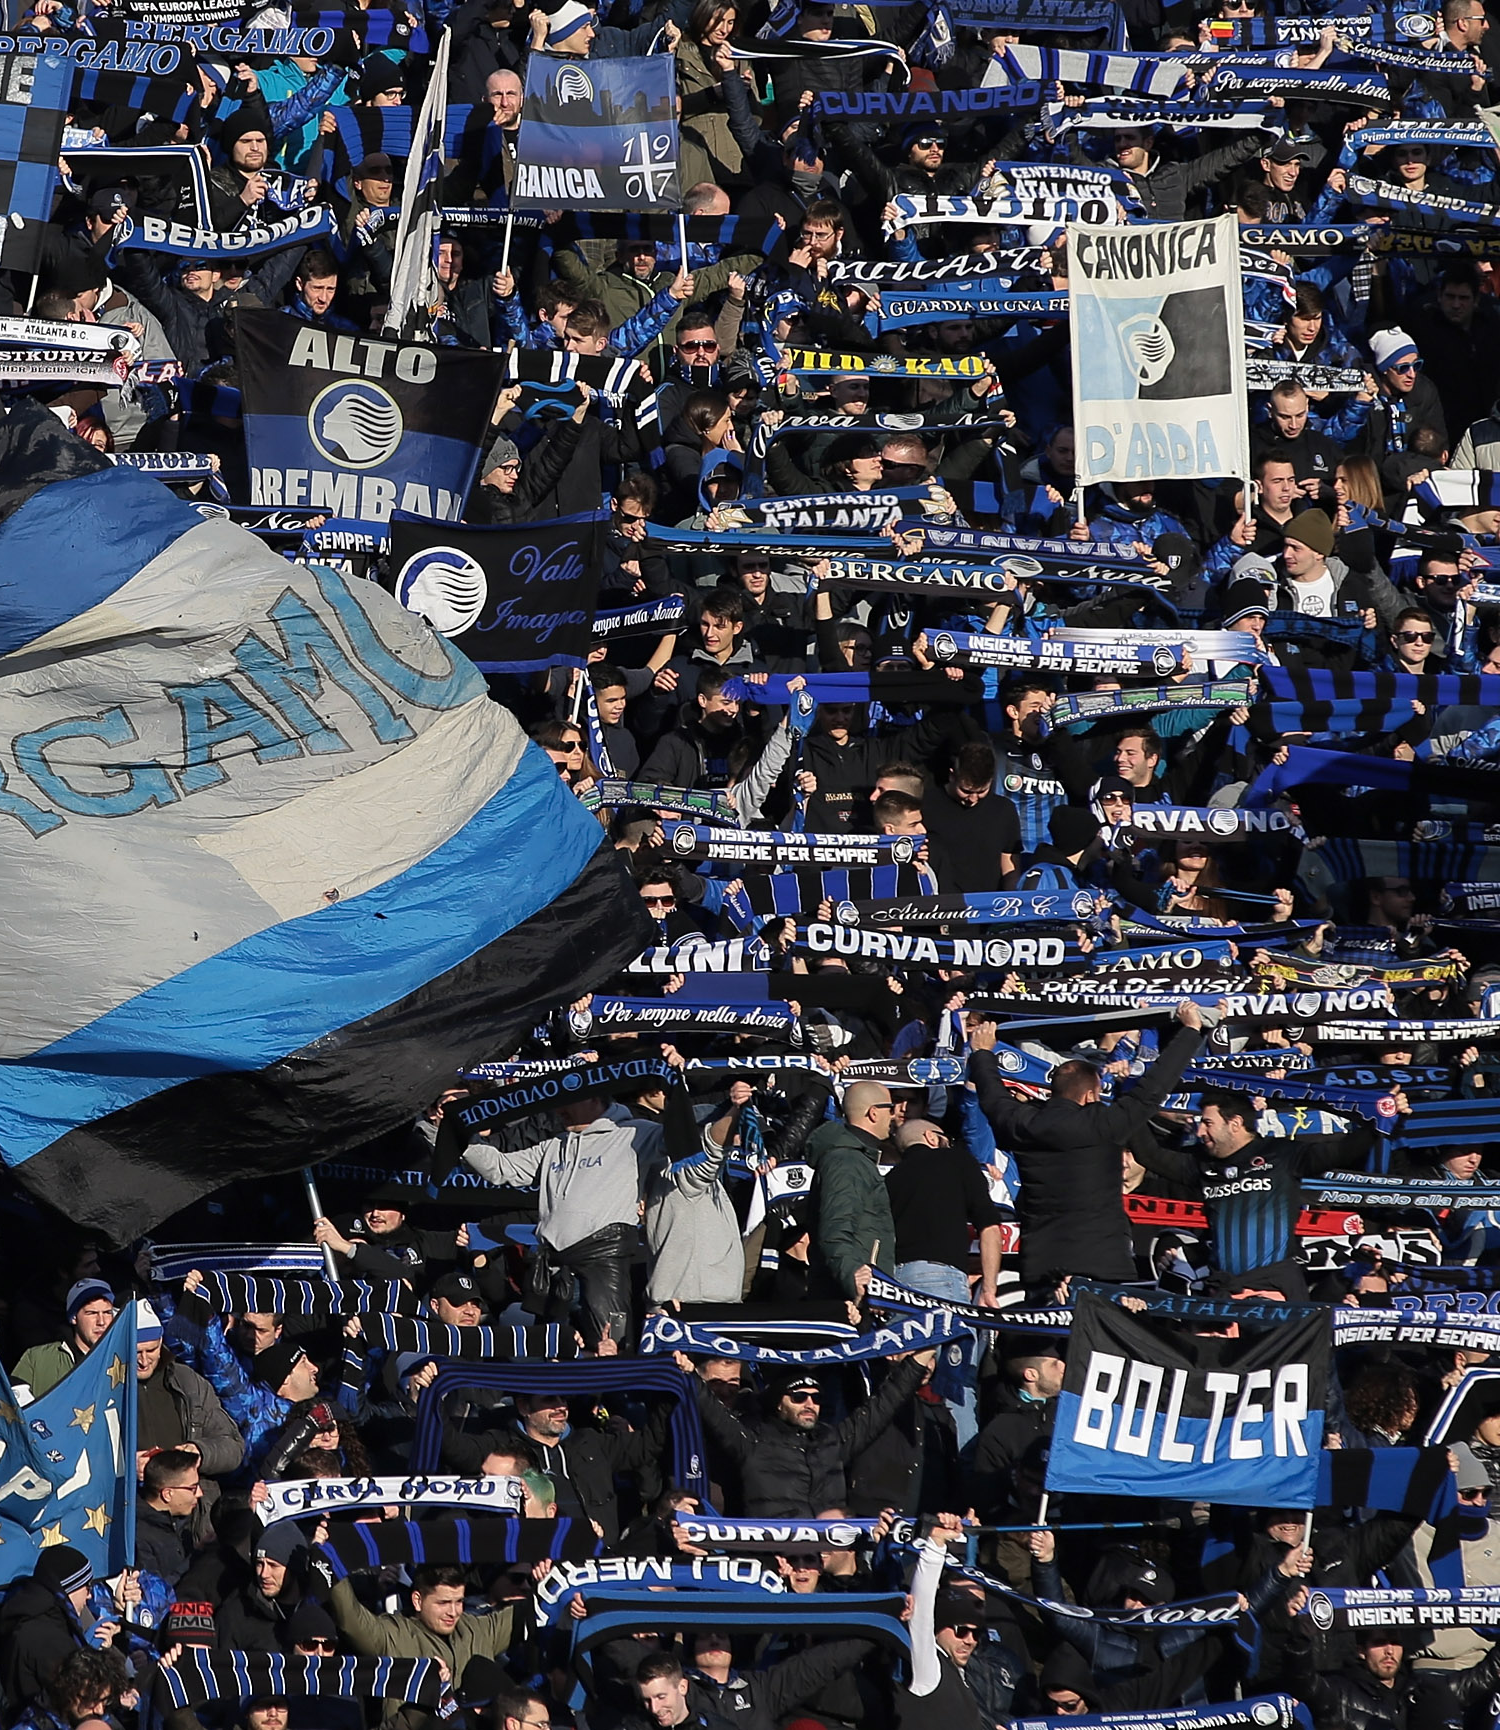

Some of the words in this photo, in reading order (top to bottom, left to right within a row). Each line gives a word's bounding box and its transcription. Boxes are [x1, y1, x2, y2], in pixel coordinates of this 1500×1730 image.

[130, 2, 163, 12] UEFA
[165, 1, 204, 12] EUROPA
[1354, 41, 1417, 65] Centenario
[1418, 54, 1475, 72] Atalanta
[1214, 70, 1241, 93] Per
[1243, 75, 1303, 94] sempre
[819, 91, 937, 115] CURVA
[653, 135, 670, 160] 9
[515, 163, 606, 199] RANICA
[1011, 165, 1112, 184] CENTENARIO
[1014, 180, 1114, 200] ATALANTA
[143, 205, 325, 250] BERGAMO
[1240, 228, 1344, 247] GAMO
[1076, 225, 1218, 281] CANONICA
[889, 300, 975, 317] GUARDIA
[24, 323, 66, 339] ATALANTA
[288, 326, 438, 385] ALTO
[1085, 420, 1222, 479] D'ADDA
[758, 493, 900, 515] CENTENARIO
[763, 506, 902, 530] ATALANTA
[315, 532, 374, 552] SEMPRE
[509, 540, 585, 584] Valle
[825, 560, 1009, 592] BERGAMO
[968, 635, 1032, 655] INSIEME
[1041, 641, 1066, 657] DA
[1073, 643, 1139, 660] SEMPRE
[1038, 655, 1070, 672] PER
[1072, 657, 1140, 675] SEMPRE
[709, 825, 774, 844] INSIEME
[708, 844, 774, 863] INSIEME
[777, 846, 811, 863] PER
[813, 846, 878, 864] SEMPRE
[870, 900, 981, 922] Atalanta
[621, 938, 744, 974] LLINI
[806, 923, 939, 967] CURVA
[952, 936, 1066, 968] NORD
[599, 1001, 636, 1025] Per
[635, 1006, 692, 1025] sempre
[695, 1006, 737, 1024] nella
[740, 1007, 788, 1029] storia
[458, 1079, 560, 1127] OVUNQUE
[1318, 1190, 1363, 1205] Non
[1365, 1191, 1409, 1207] solo
[1411, 1192, 1453, 1208] alla
[1334, 1308, 1402, 1326] INSIEME
[1409, 1310, 1439, 1326] DA
[1333, 1326, 1396, 1347] INSIEME
[1397, 1326, 1433, 1346] PER
[1072, 1350, 1309, 1464] BOLTER
[684, 1521, 819, 1543] CURVA
[1343, 1587, 1415, 1605] INSIEME
[1425, 1588, 1452, 1602] DA
[1108, 1599, 1240, 1626] Nord
[1346, 1606, 1417, 1627] INSIEME
[1419, 1606, 1456, 1625] PER
